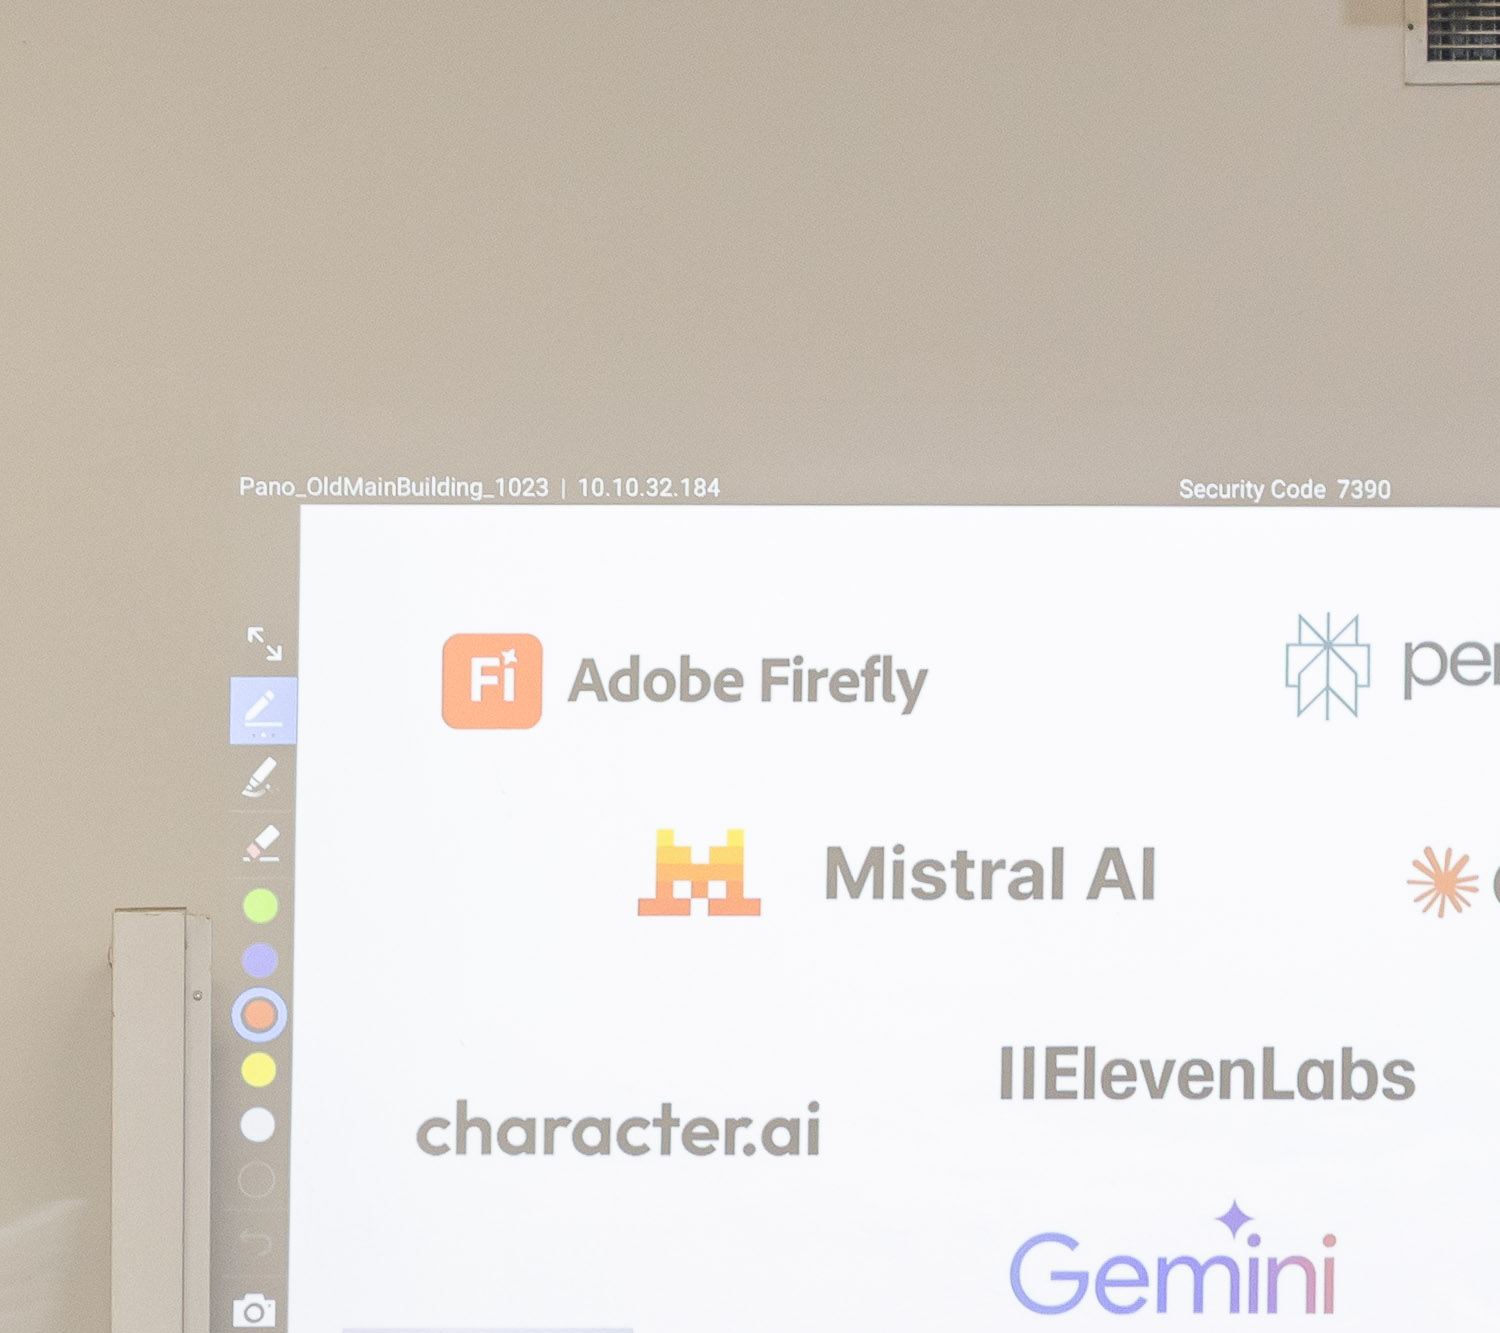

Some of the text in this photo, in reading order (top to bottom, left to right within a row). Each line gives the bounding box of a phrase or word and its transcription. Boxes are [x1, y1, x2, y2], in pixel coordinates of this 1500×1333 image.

[239, 476, 550, 501] Pano_OldMainBuilding_1023
[578, 477, 721, 498] 10.10.32.184
[1179, 478, 1391, 503] Security Code 7390
[567, 654, 929, 716] Adobe Firefly
[825, 843, 1156, 901] Mistral AI
[415, 1098, 820, 1158] character.ai
[1009, 1231, 1338, 1316] Gemini
